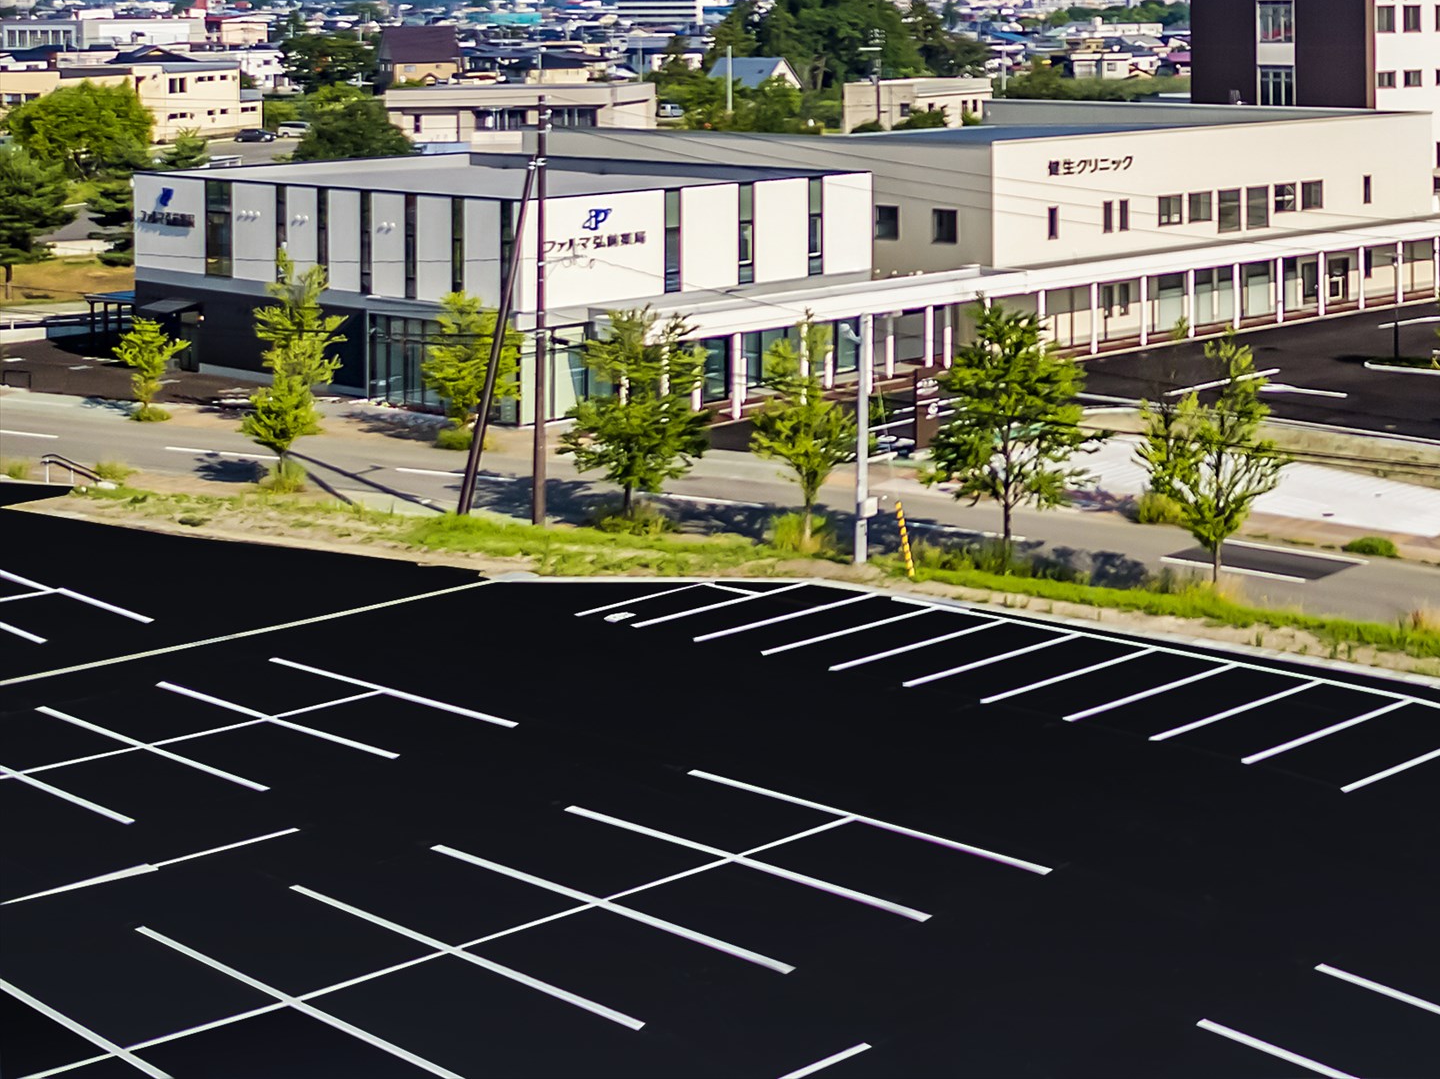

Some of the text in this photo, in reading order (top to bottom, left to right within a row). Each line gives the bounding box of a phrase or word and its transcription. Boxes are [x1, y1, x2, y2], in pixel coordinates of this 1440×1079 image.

[1048, 156, 1133, 176] 健生クリニック
